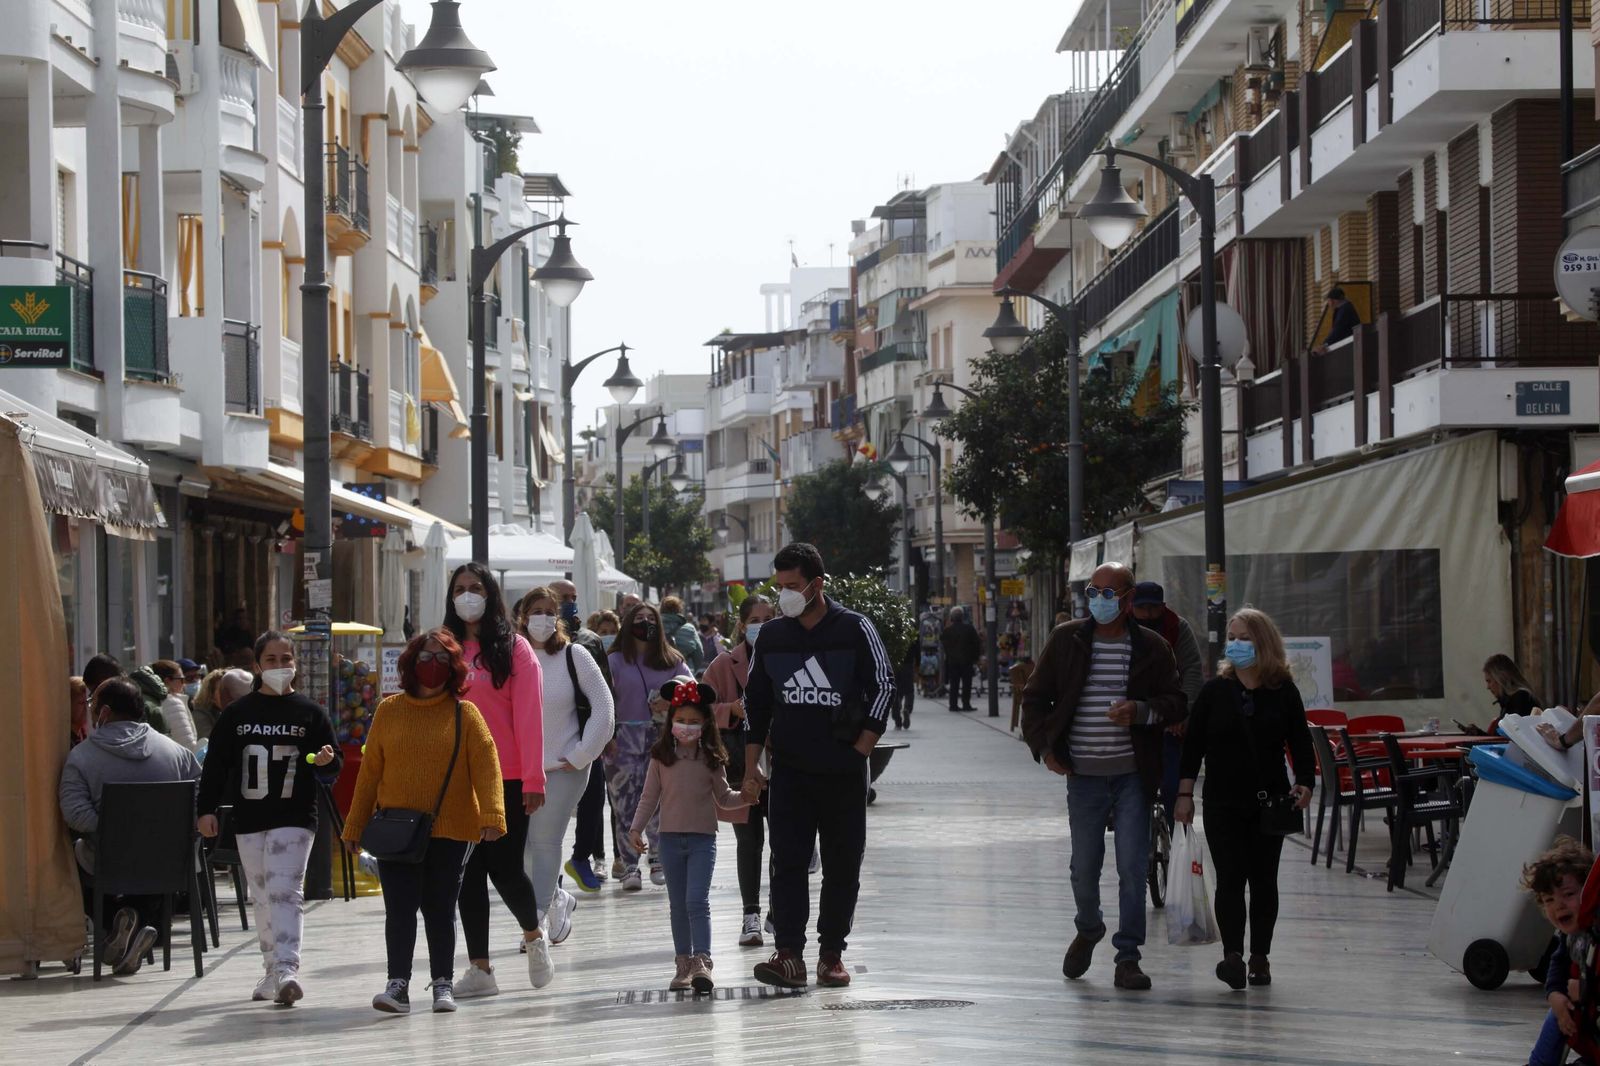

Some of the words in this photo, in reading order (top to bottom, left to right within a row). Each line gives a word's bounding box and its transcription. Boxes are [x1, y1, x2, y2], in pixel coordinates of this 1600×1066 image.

[1563, 263, 1583, 272] 959
[1586, 262, 1597, 271] 31
[25, 326, 63, 336] RURAL
[14, 348, 64, 359] ServiRed
[1532, 383, 1562, 391] CALLE
[1525, 403, 1561, 414] DELFIN
[781, 686, 842, 707] adidas
[236, 723, 306, 738] SPARKLES
[240, 743, 300, 800] 07
